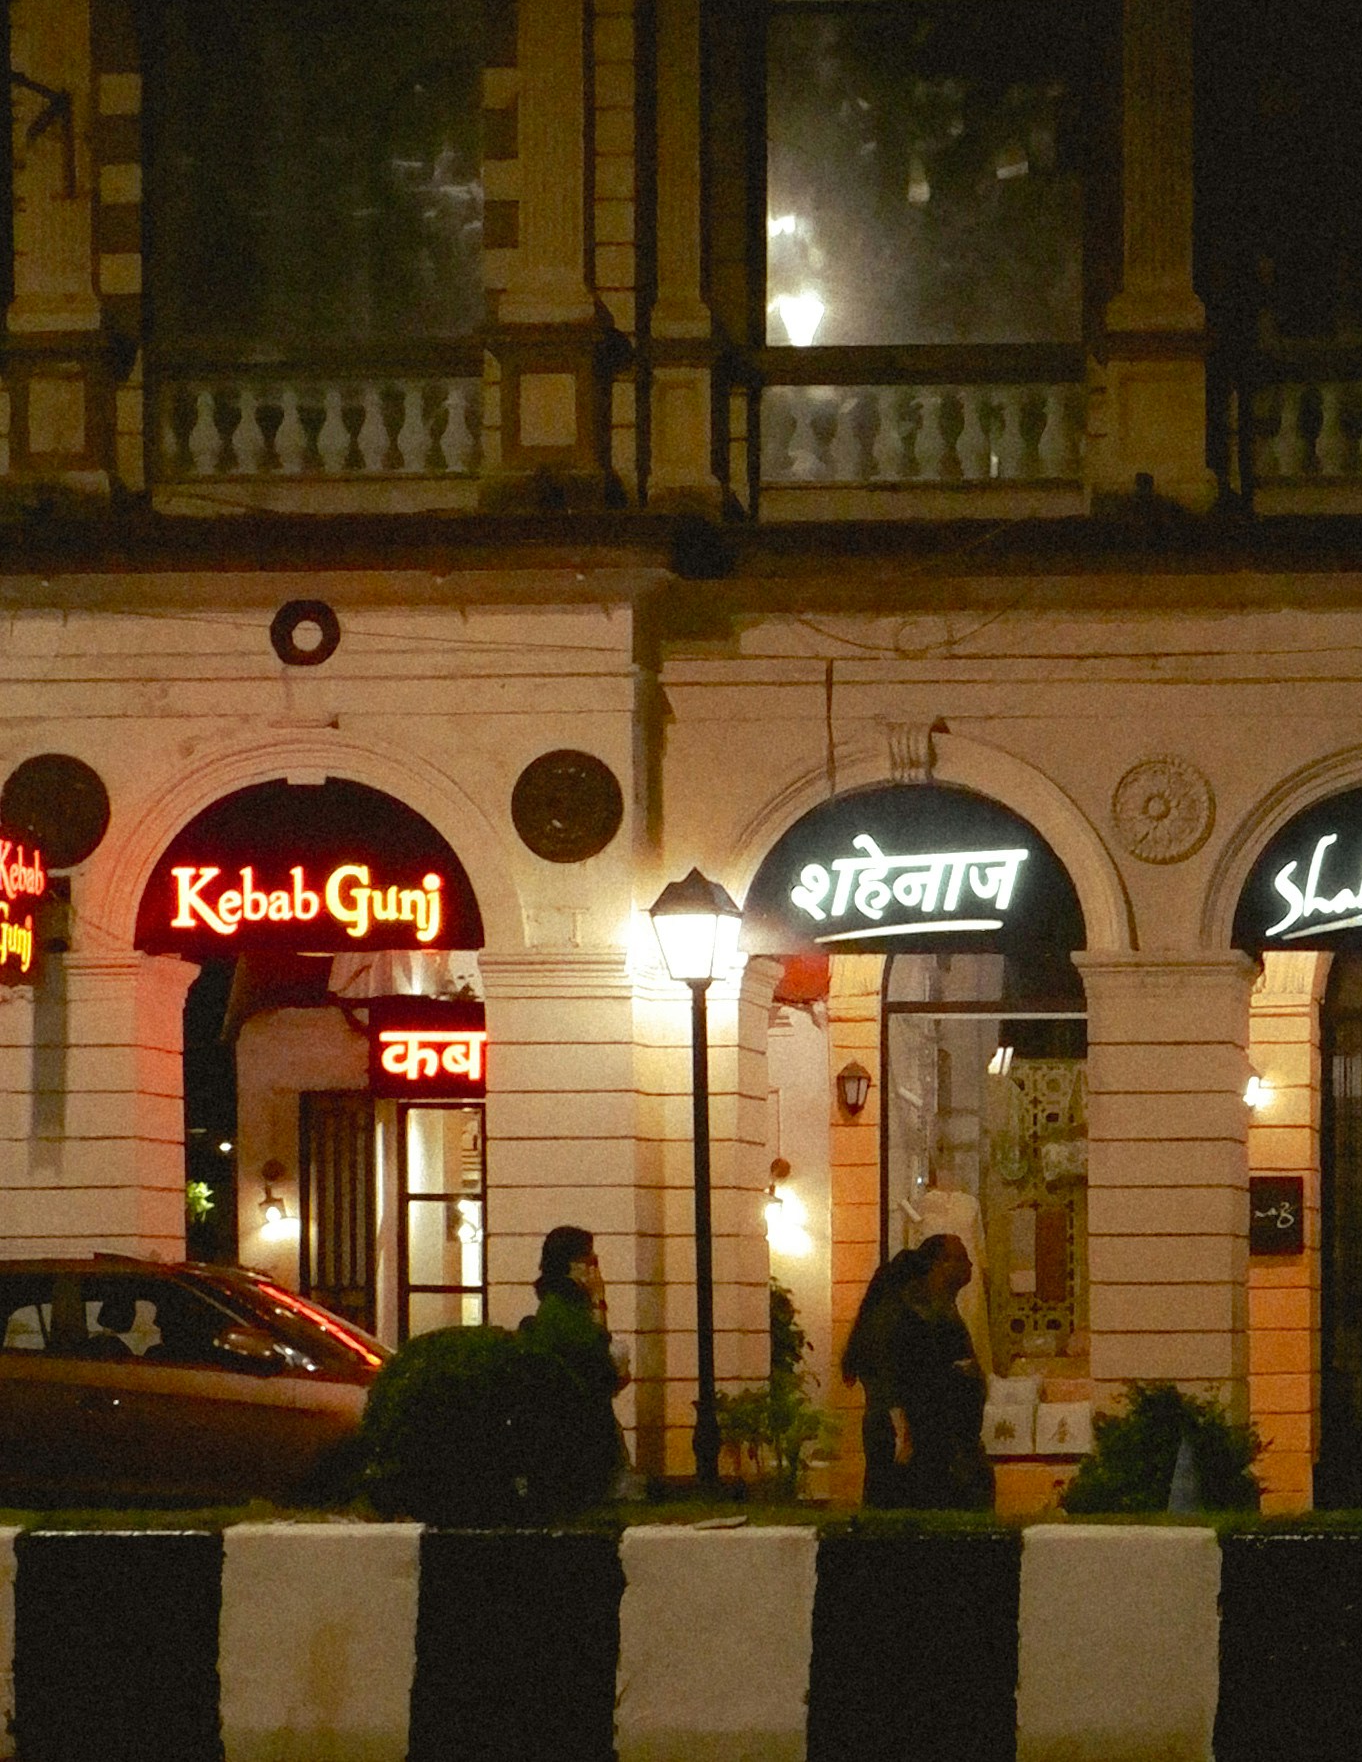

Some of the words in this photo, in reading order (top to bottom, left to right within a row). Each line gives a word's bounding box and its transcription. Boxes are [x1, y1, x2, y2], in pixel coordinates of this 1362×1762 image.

[169, 865, 319, 935] Kebab
[325, 864, 442, 942] Gunj
[791, 834, 1029, 920] शहेनाज
